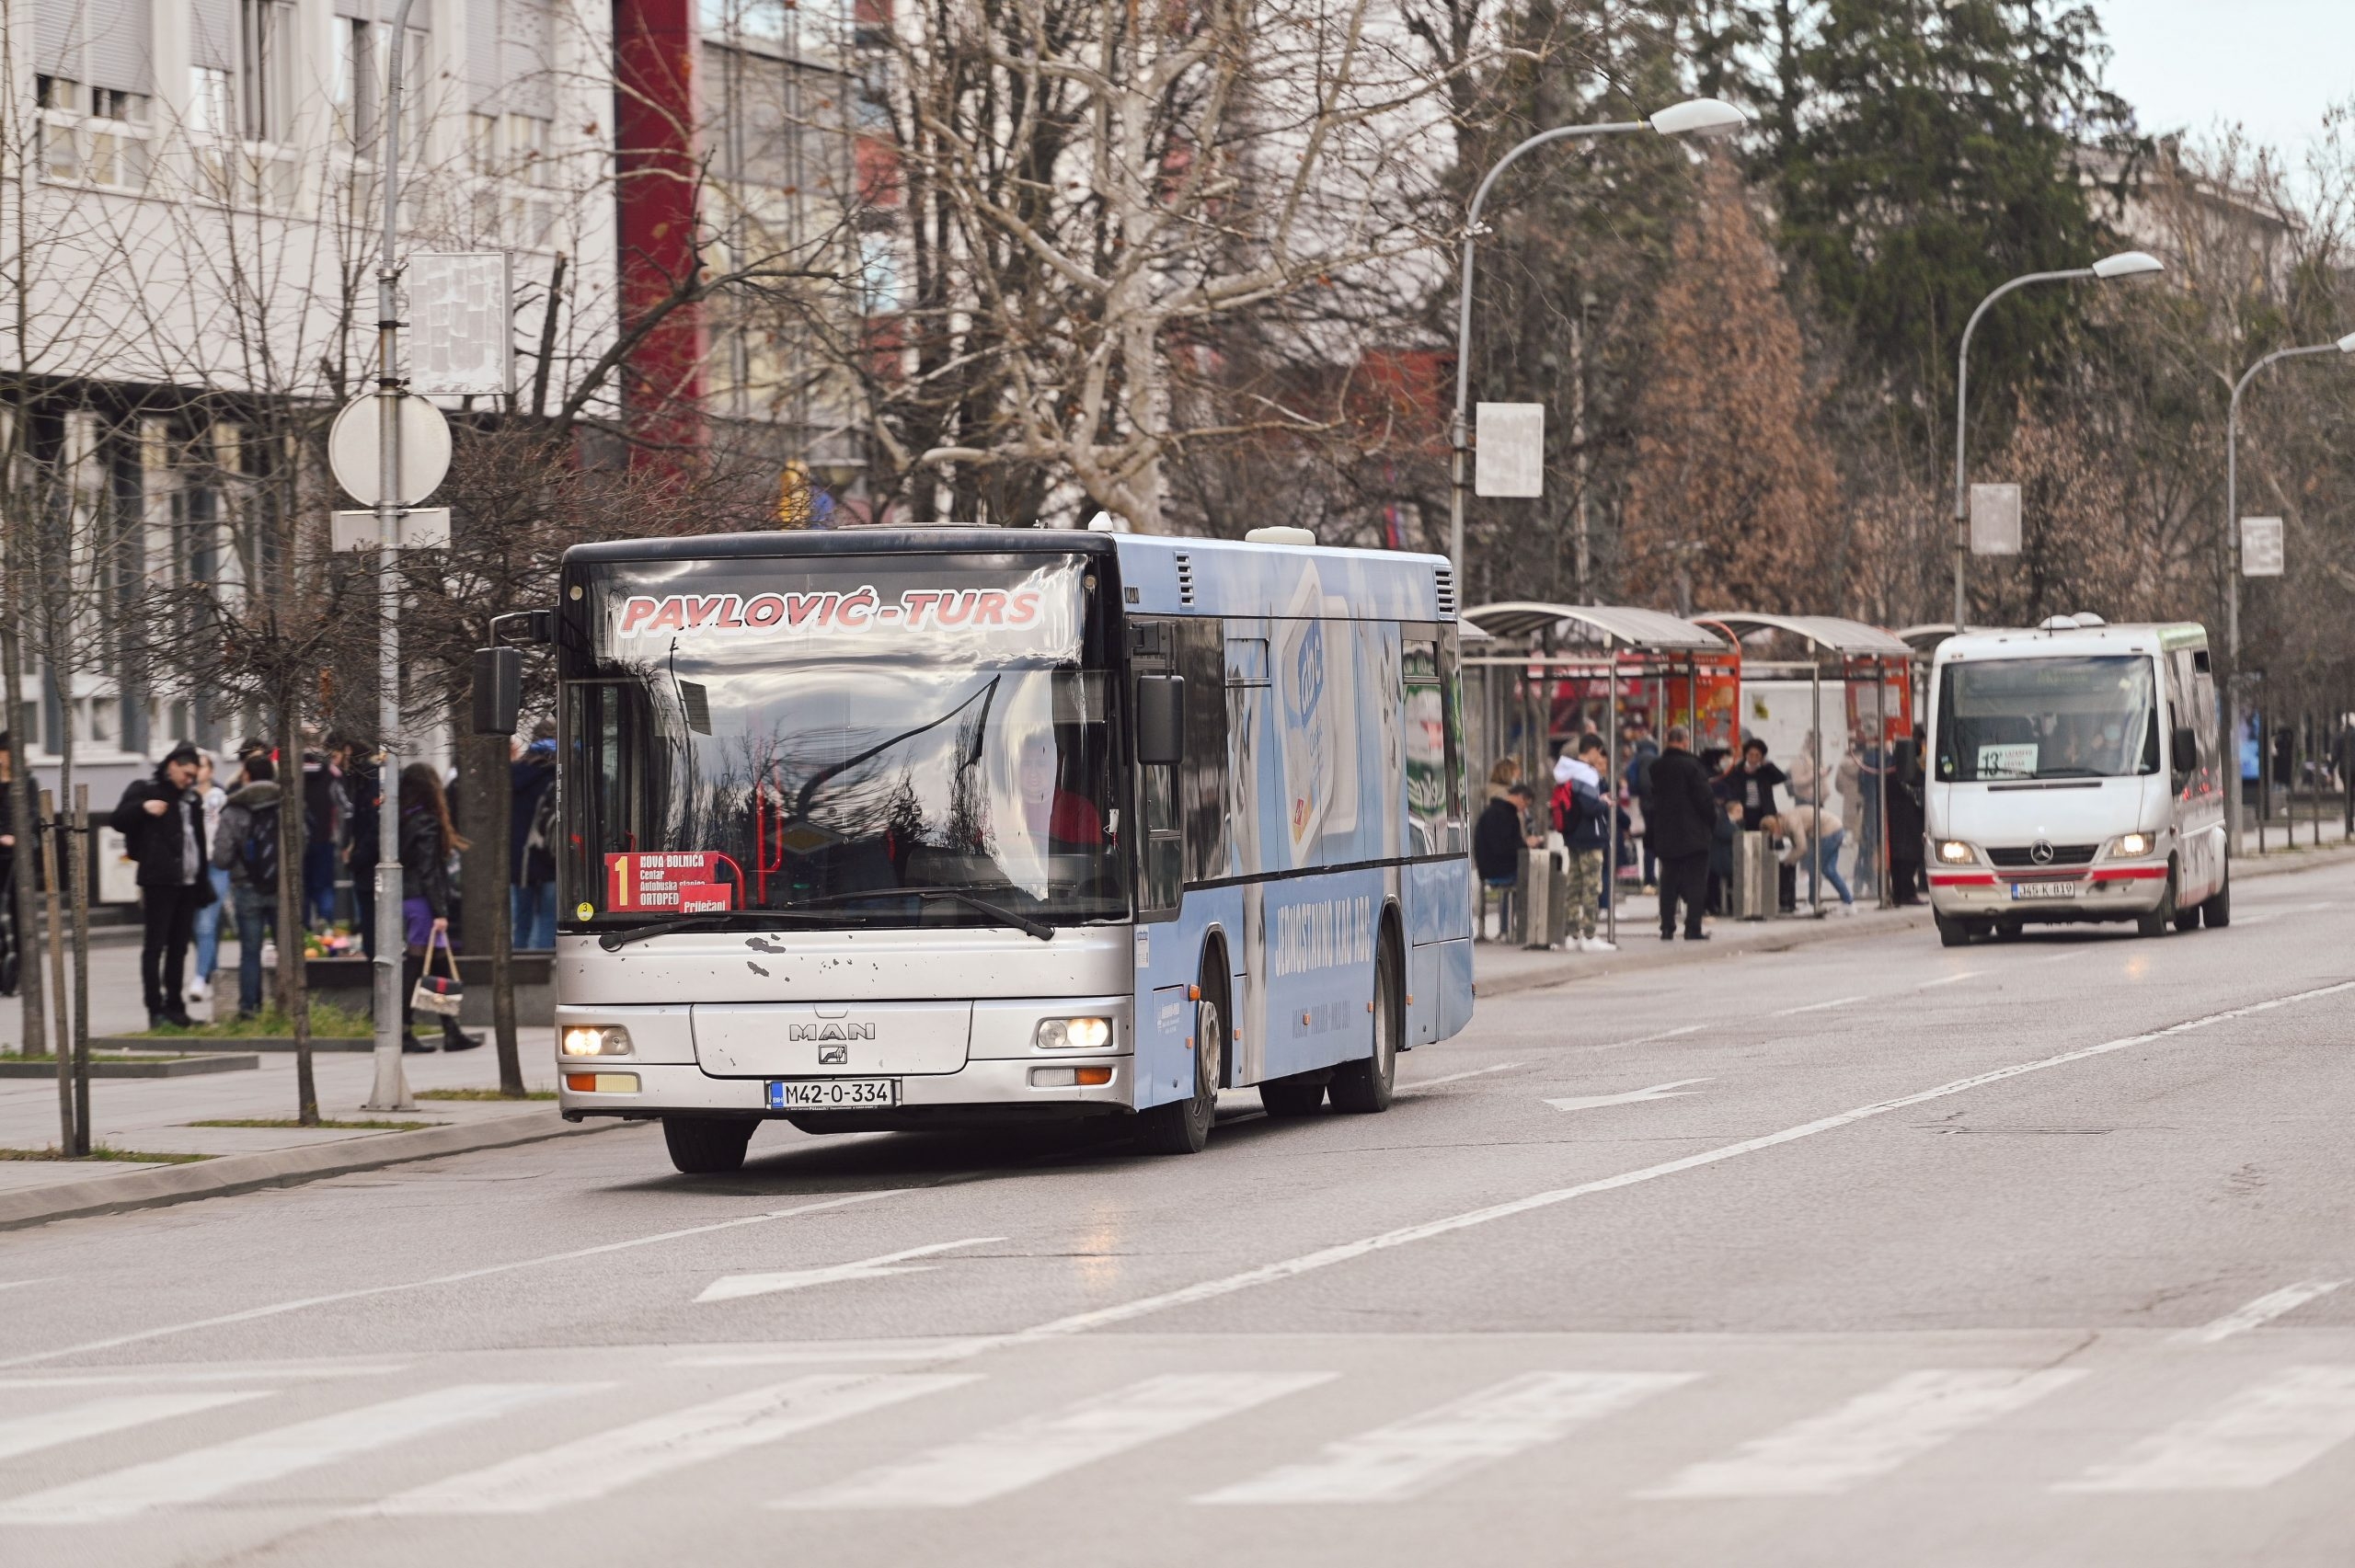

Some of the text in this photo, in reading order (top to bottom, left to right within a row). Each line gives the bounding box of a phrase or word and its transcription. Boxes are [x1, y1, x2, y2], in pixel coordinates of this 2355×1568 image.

[639, 854, 705, 868] NOVA BOLNICA
[615, 855, 628, 907] 1
[639, 880, 678, 891] Autobuska
[1275, 895, 1370, 978] JEDNOSTAVNO KAO ABC
[789, 1023, 876, 1041] MAN
